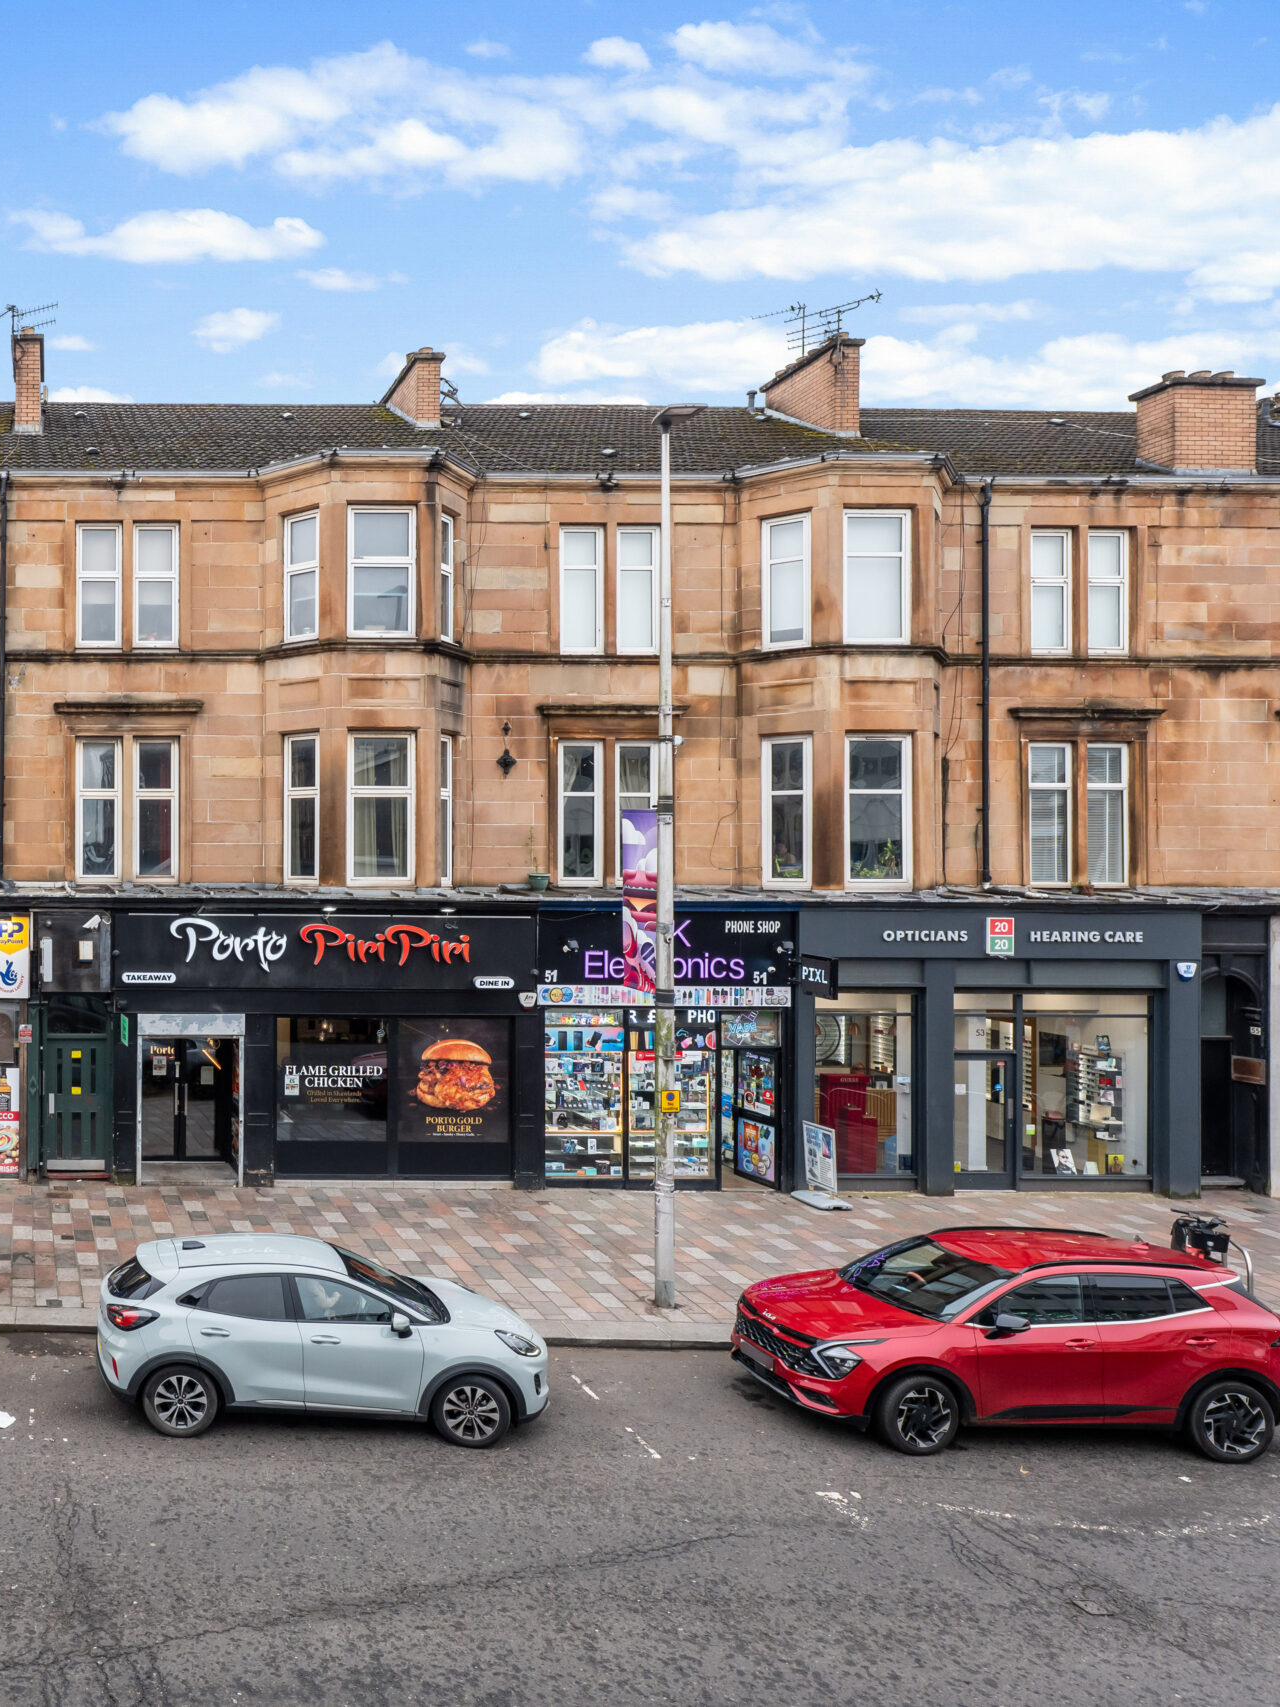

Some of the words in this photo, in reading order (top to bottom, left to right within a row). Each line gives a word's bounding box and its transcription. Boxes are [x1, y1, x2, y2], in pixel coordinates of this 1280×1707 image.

[725, 921, 755, 933] PHONE
[757, 921, 781, 933] SHOP
[994, 921, 1009, 933] 20
[882, 930, 969, 943] OPTICIANS
[1029, 930, 1101, 943] HEARING
[1103, 931, 1144, 943] CARE
[169, 917, 287, 973] Porto
[994, 939, 1009, 950] 20
[584, 950, 746, 980] Eleonics
[544, 969, 558, 983] 51
[753, 971, 767, 985] 51
[802, 966, 828, 984] PIXL
[14, 975, 25, 991] Lottery
[728, 1022, 758, 1034] VAPE
[976, 1029, 985, 1037] 53
[1251, 1027, 1260, 1035] 55
[285, 1065, 327, 1076] FLAME
[329, 1065, 383, 1076] GRILLED
[304, 1077, 363, 1088] CHICKEN
[425, 1116, 456, 1125] PORTO
[457, 1116, 483, 1125] GOLD
[436, 1125, 472, 1133] BURGER
